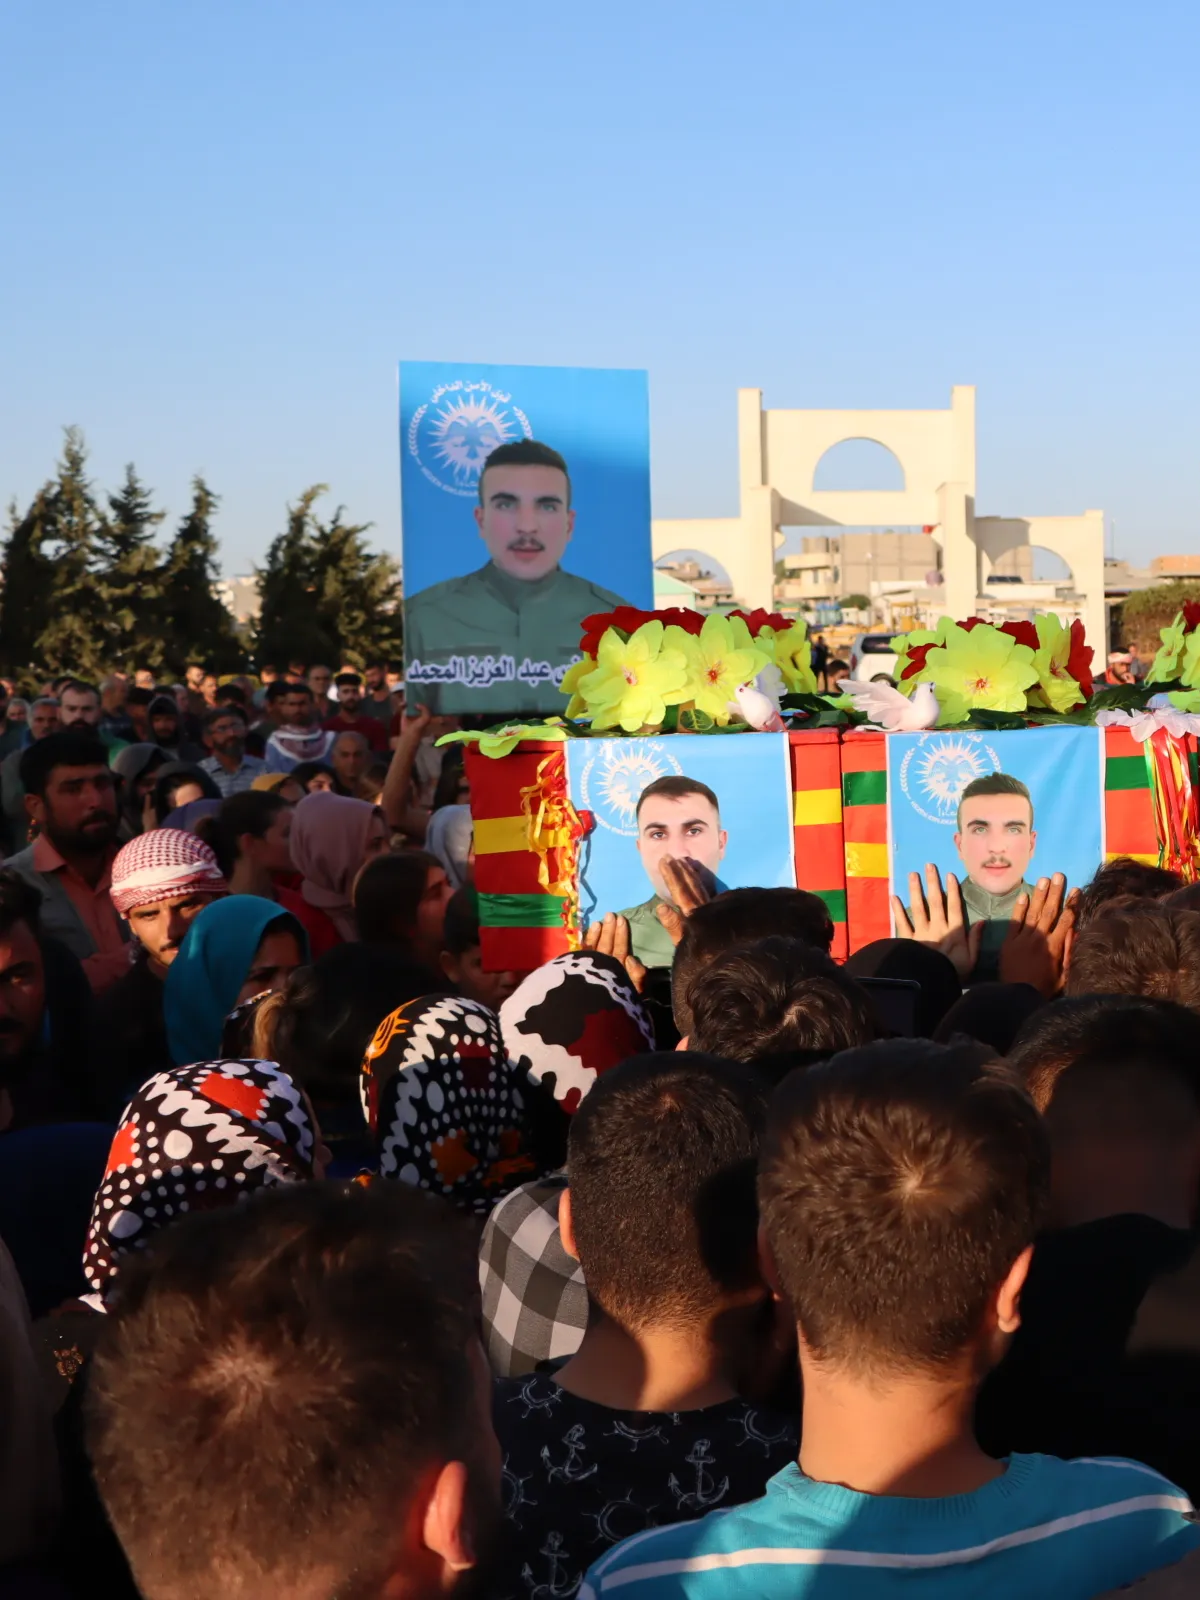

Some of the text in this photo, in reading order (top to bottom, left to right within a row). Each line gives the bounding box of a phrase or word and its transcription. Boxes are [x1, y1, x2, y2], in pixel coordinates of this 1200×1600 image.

[407, 656, 464, 684] المحمد
[465, 654, 515, 687] العزيز
[517, 657, 551, 687] عبد
